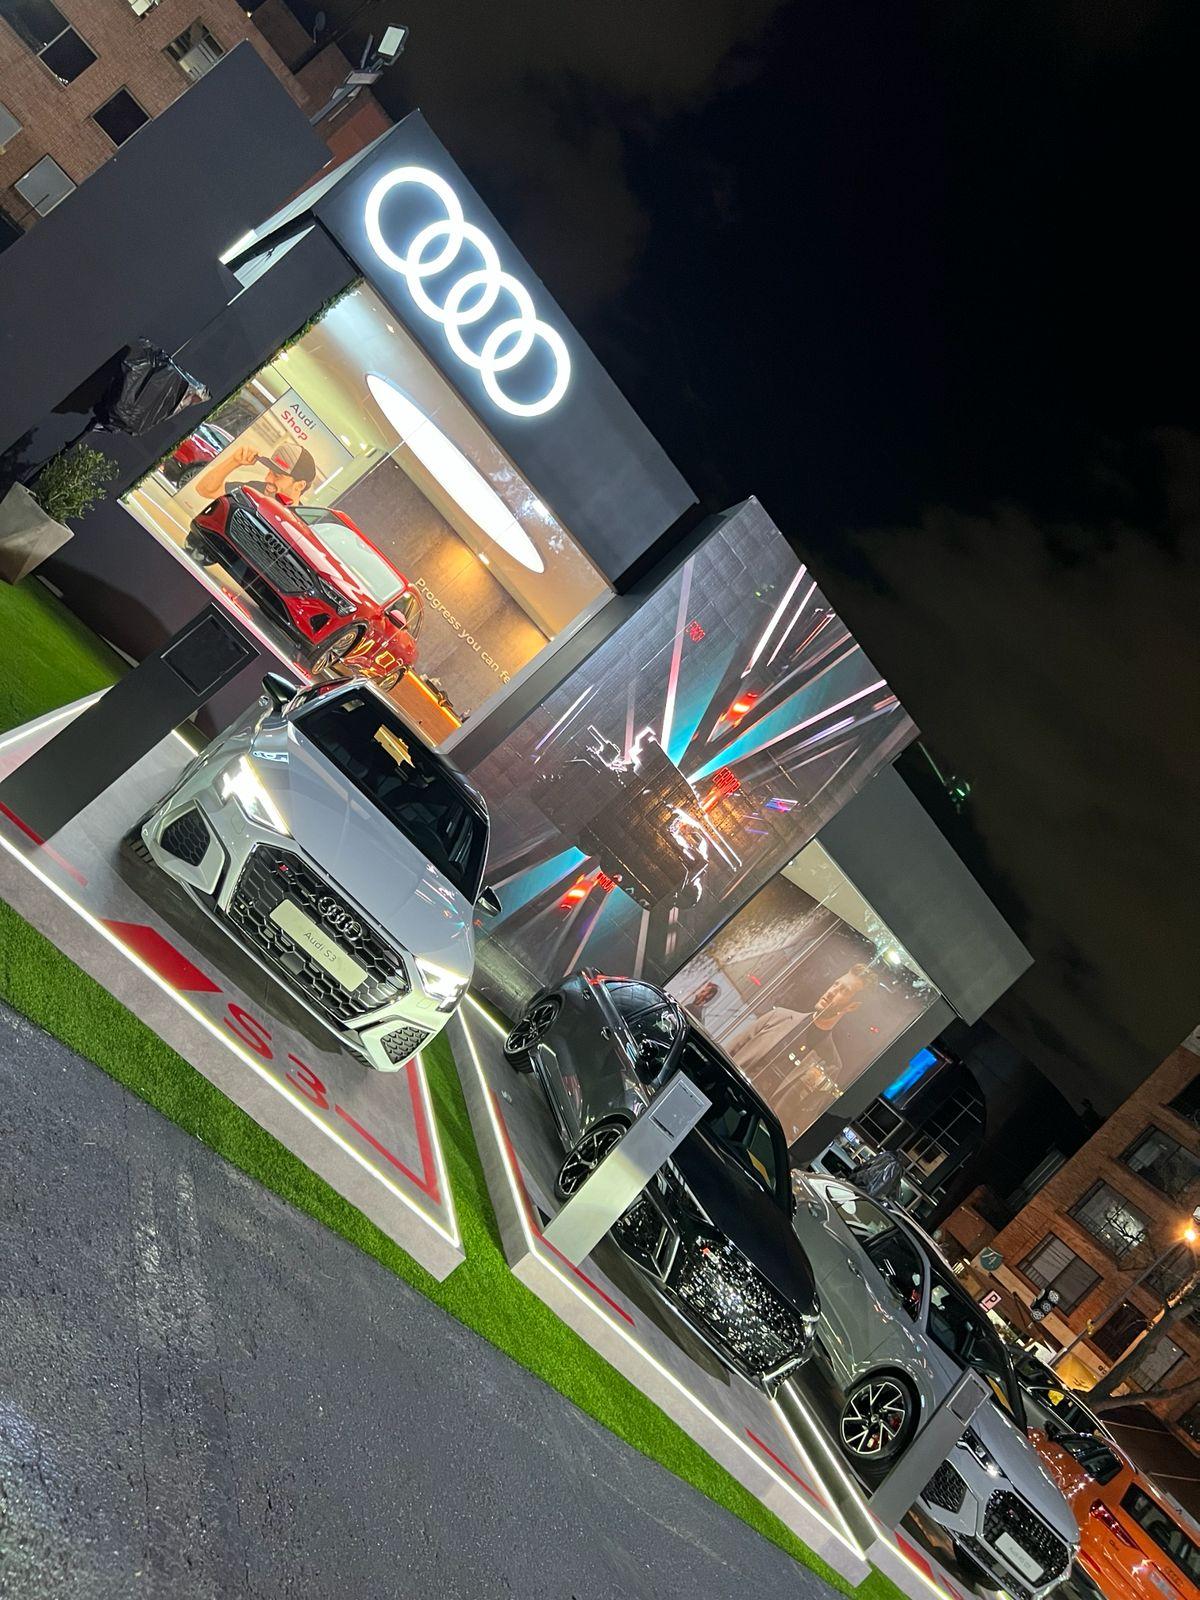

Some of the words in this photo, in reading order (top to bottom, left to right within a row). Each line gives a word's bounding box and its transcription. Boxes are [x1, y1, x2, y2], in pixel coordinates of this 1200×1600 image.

[281, 410, 308, 441] Shop
[290, 403, 316, 430] Audi
[415, 577, 461, 630] Progress
[458, 629, 481, 652] you
[481, 651, 499, 672] can
[712, 766, 741, 799] ERROR
[303, 932, 325, 951] Audi
[324, 949, 337, 962] S3
[223, 1002, 330, 1111] S3
[984, 1293, 998, 1304] P
